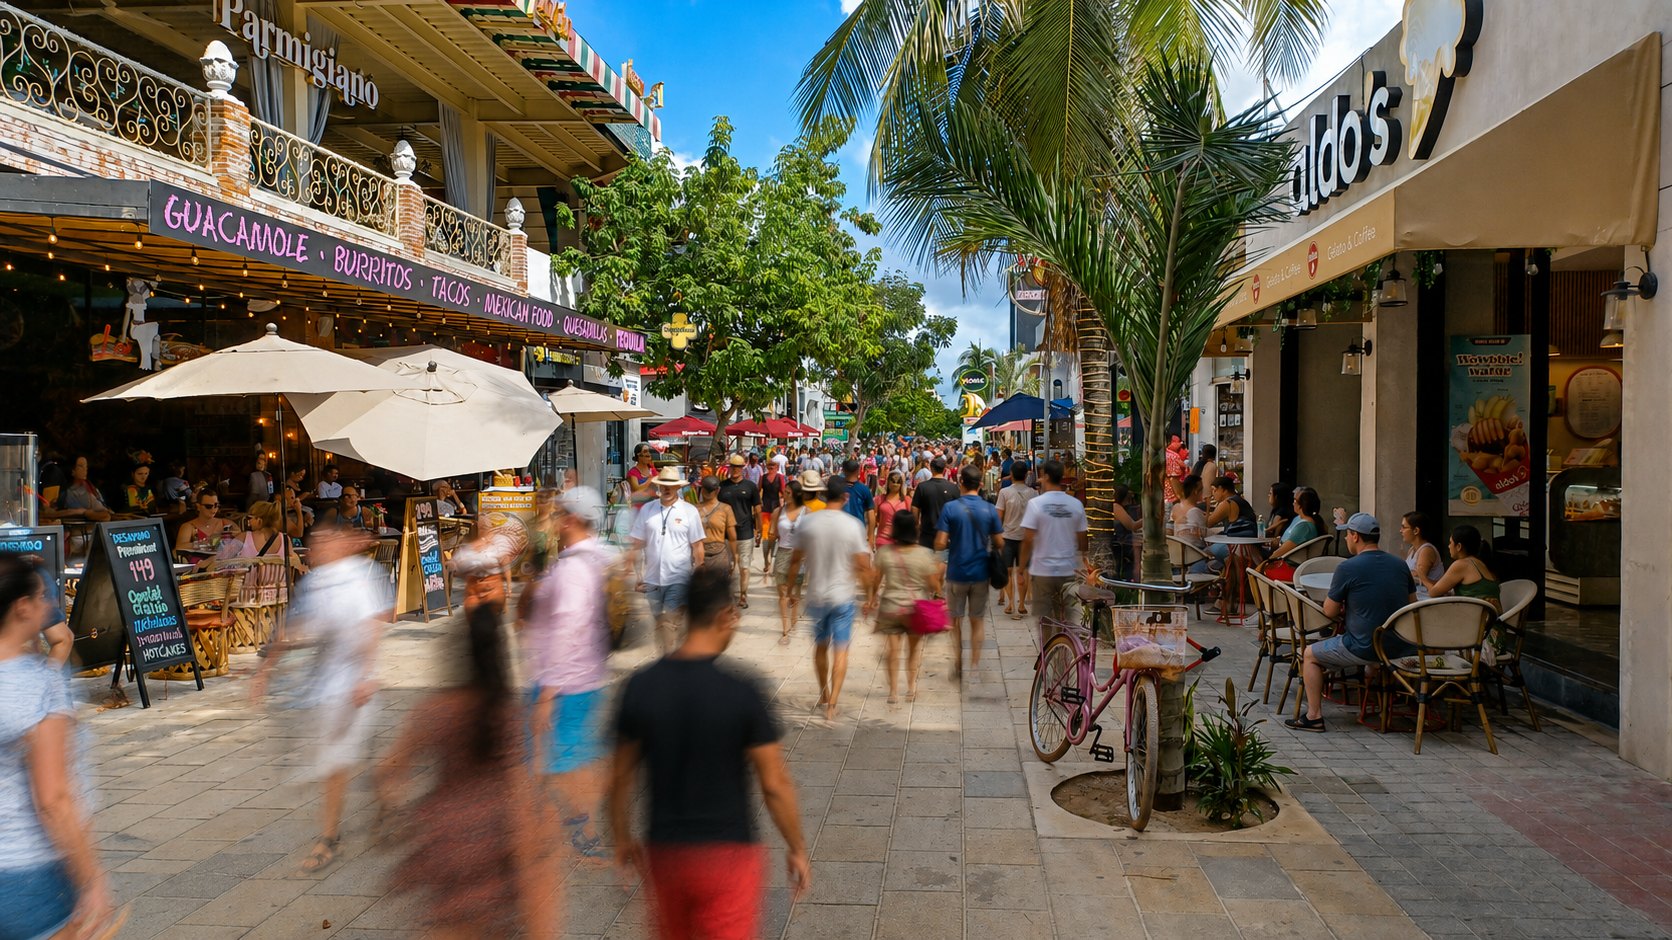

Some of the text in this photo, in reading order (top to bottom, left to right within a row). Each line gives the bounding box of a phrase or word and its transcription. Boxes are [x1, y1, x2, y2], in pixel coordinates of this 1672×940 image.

[213, 0, 379, 110] Parmigiano
[1288, 71, 1400, 216] aldo's
[1354, 225, 1377, 248] Coffee
[164, 194, 646, 352] GUACAMOLE BURRITOS TACOS MEXICAN FOOD QUESADILLAS TEQUILA
[129, 558, 155, 582] 149
[142, 643, 187, 662] HOTCAKES
